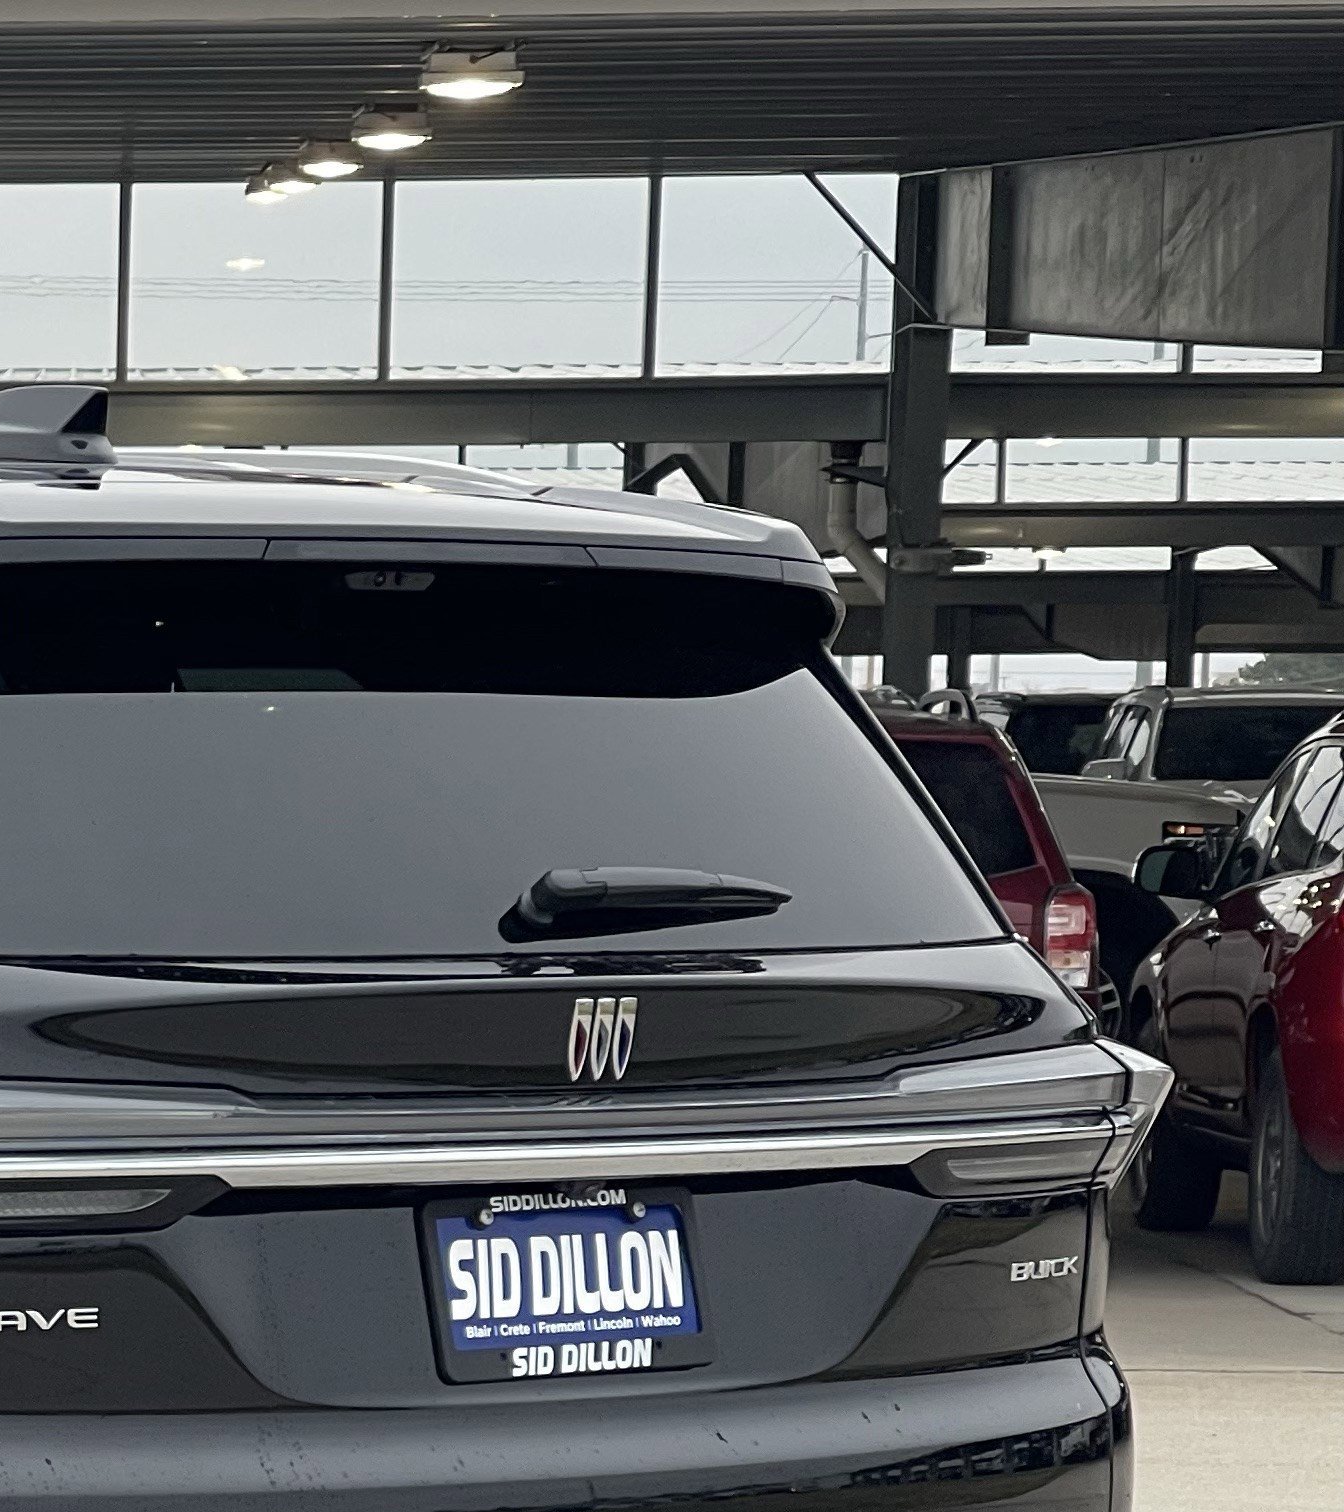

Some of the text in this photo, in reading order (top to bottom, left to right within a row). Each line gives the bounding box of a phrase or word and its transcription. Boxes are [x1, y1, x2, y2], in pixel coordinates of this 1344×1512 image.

[449, 1229, 683, 1320] SID DILLON
[1010, 1255, 1079, 1282] BUICK
[465, 1314, 682, 1339] Blair Crete Fremont Lincoln Wahoo
[512, 1337, 653, 1377] SID DILLON
